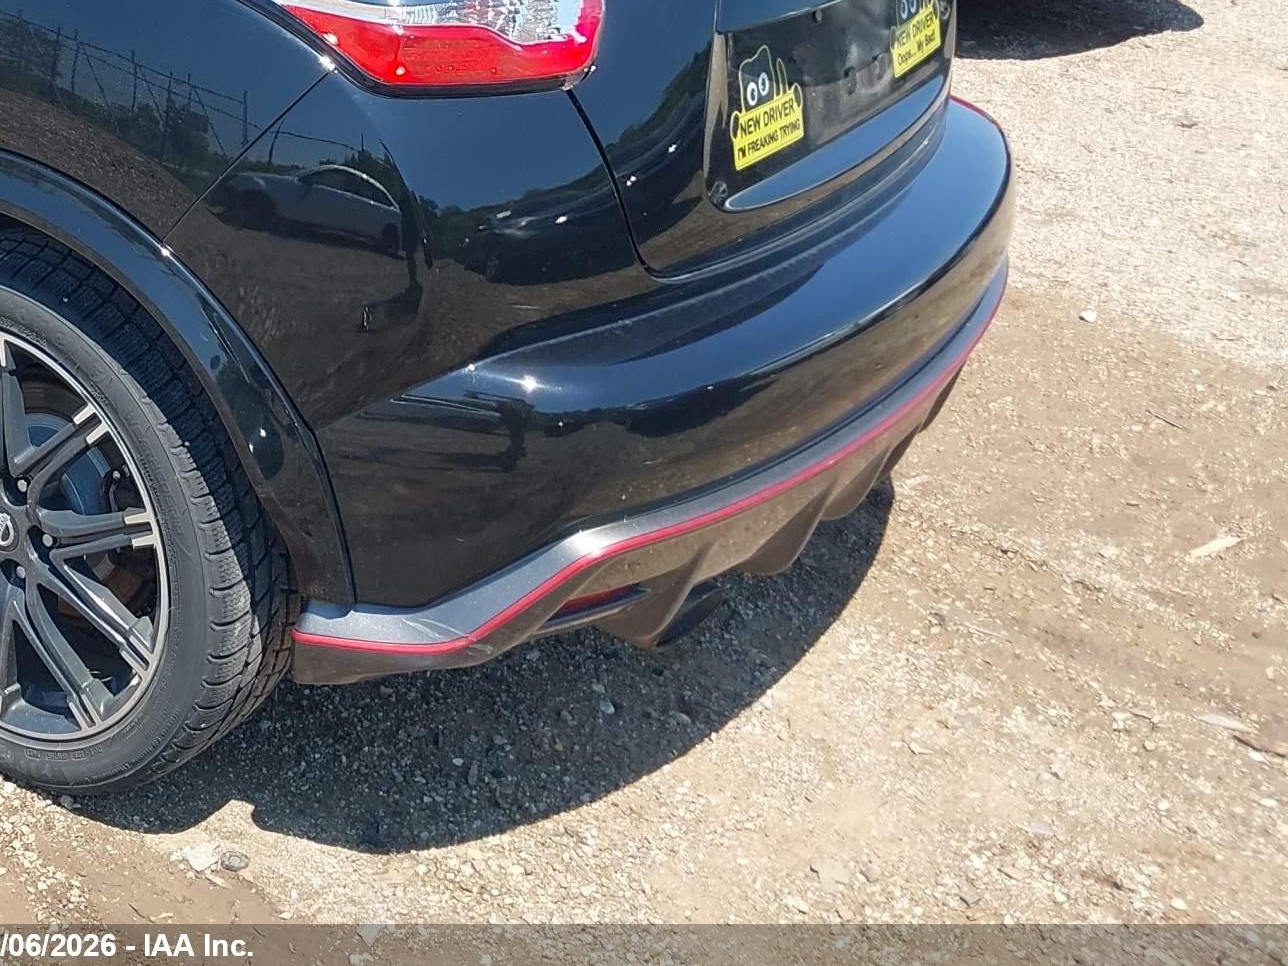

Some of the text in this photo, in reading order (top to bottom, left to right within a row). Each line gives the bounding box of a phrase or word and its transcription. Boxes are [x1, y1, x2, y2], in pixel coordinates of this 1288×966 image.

[896, 12, 934, 49] NEW DRIVER
[739, 97, 795, 139] NEW DRIVER
[737, 118, 800, 161] I'M FREAKING TRYING
